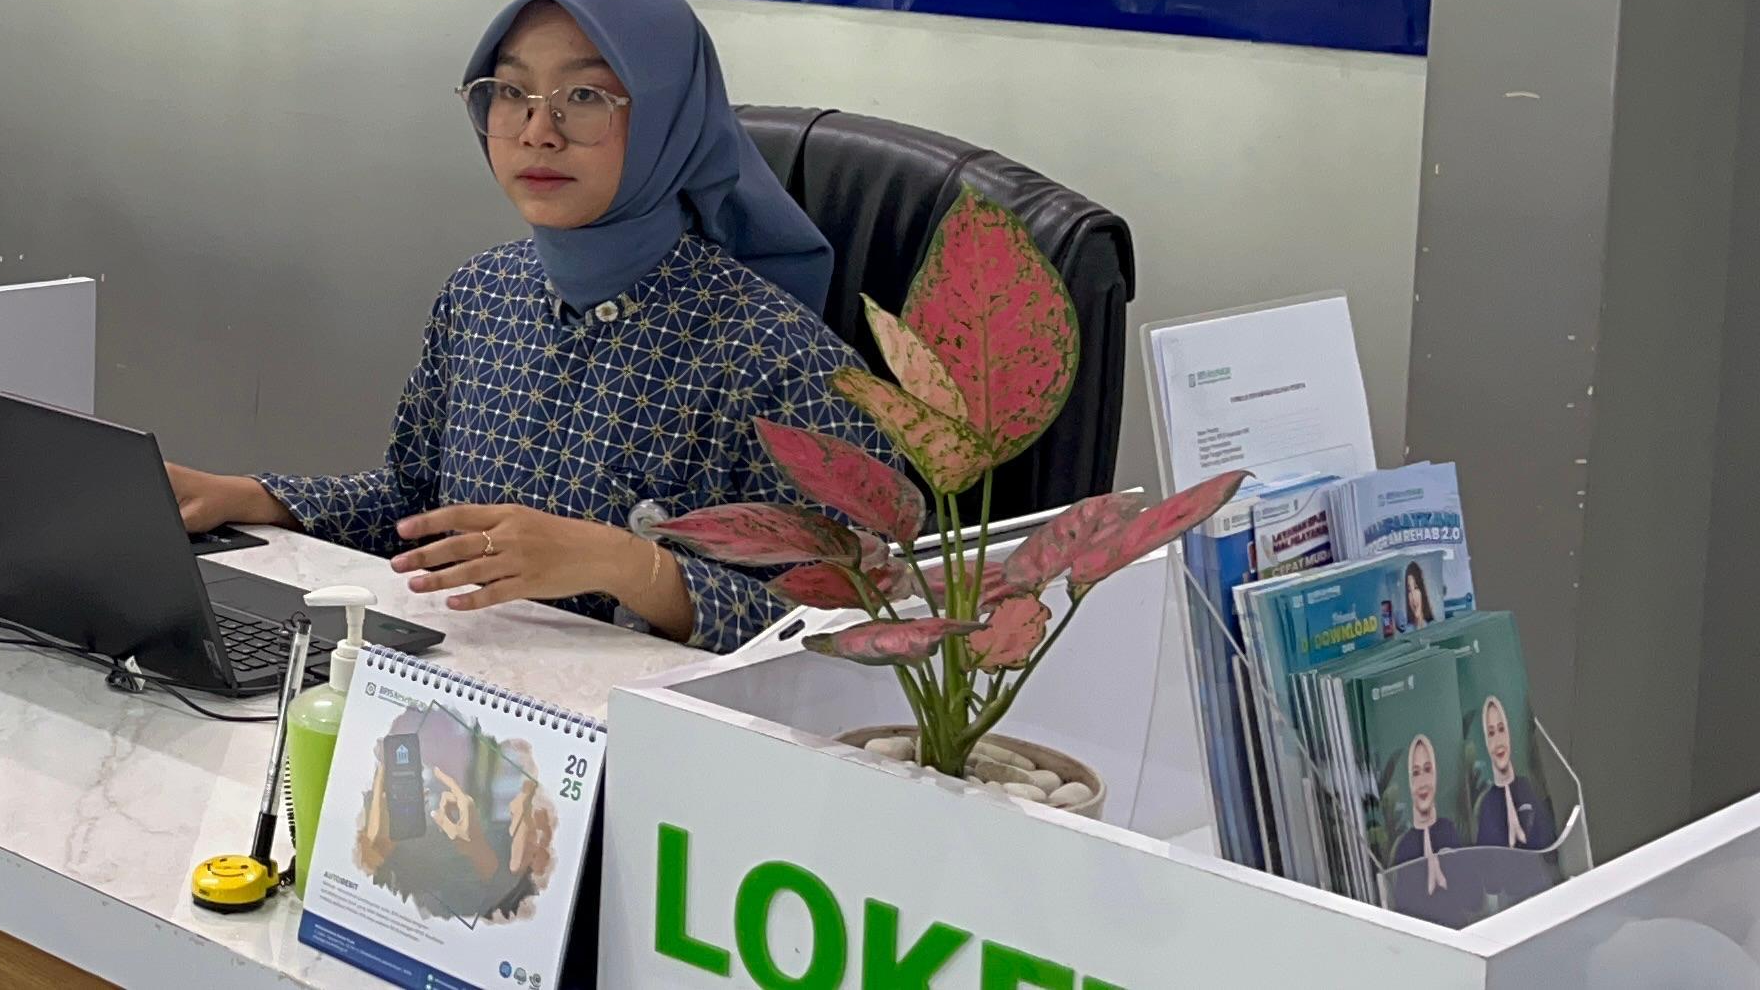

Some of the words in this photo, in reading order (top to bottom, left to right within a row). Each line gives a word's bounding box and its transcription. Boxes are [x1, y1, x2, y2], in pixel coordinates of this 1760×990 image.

[1403, 527, 1440, 542] REHAB
[1441, 526, 1460, 540] 2.0
[564, 754, 588, 778] 20
[559, 777, 583, 801] 25
[655, 822, 1129, 990] LOK
